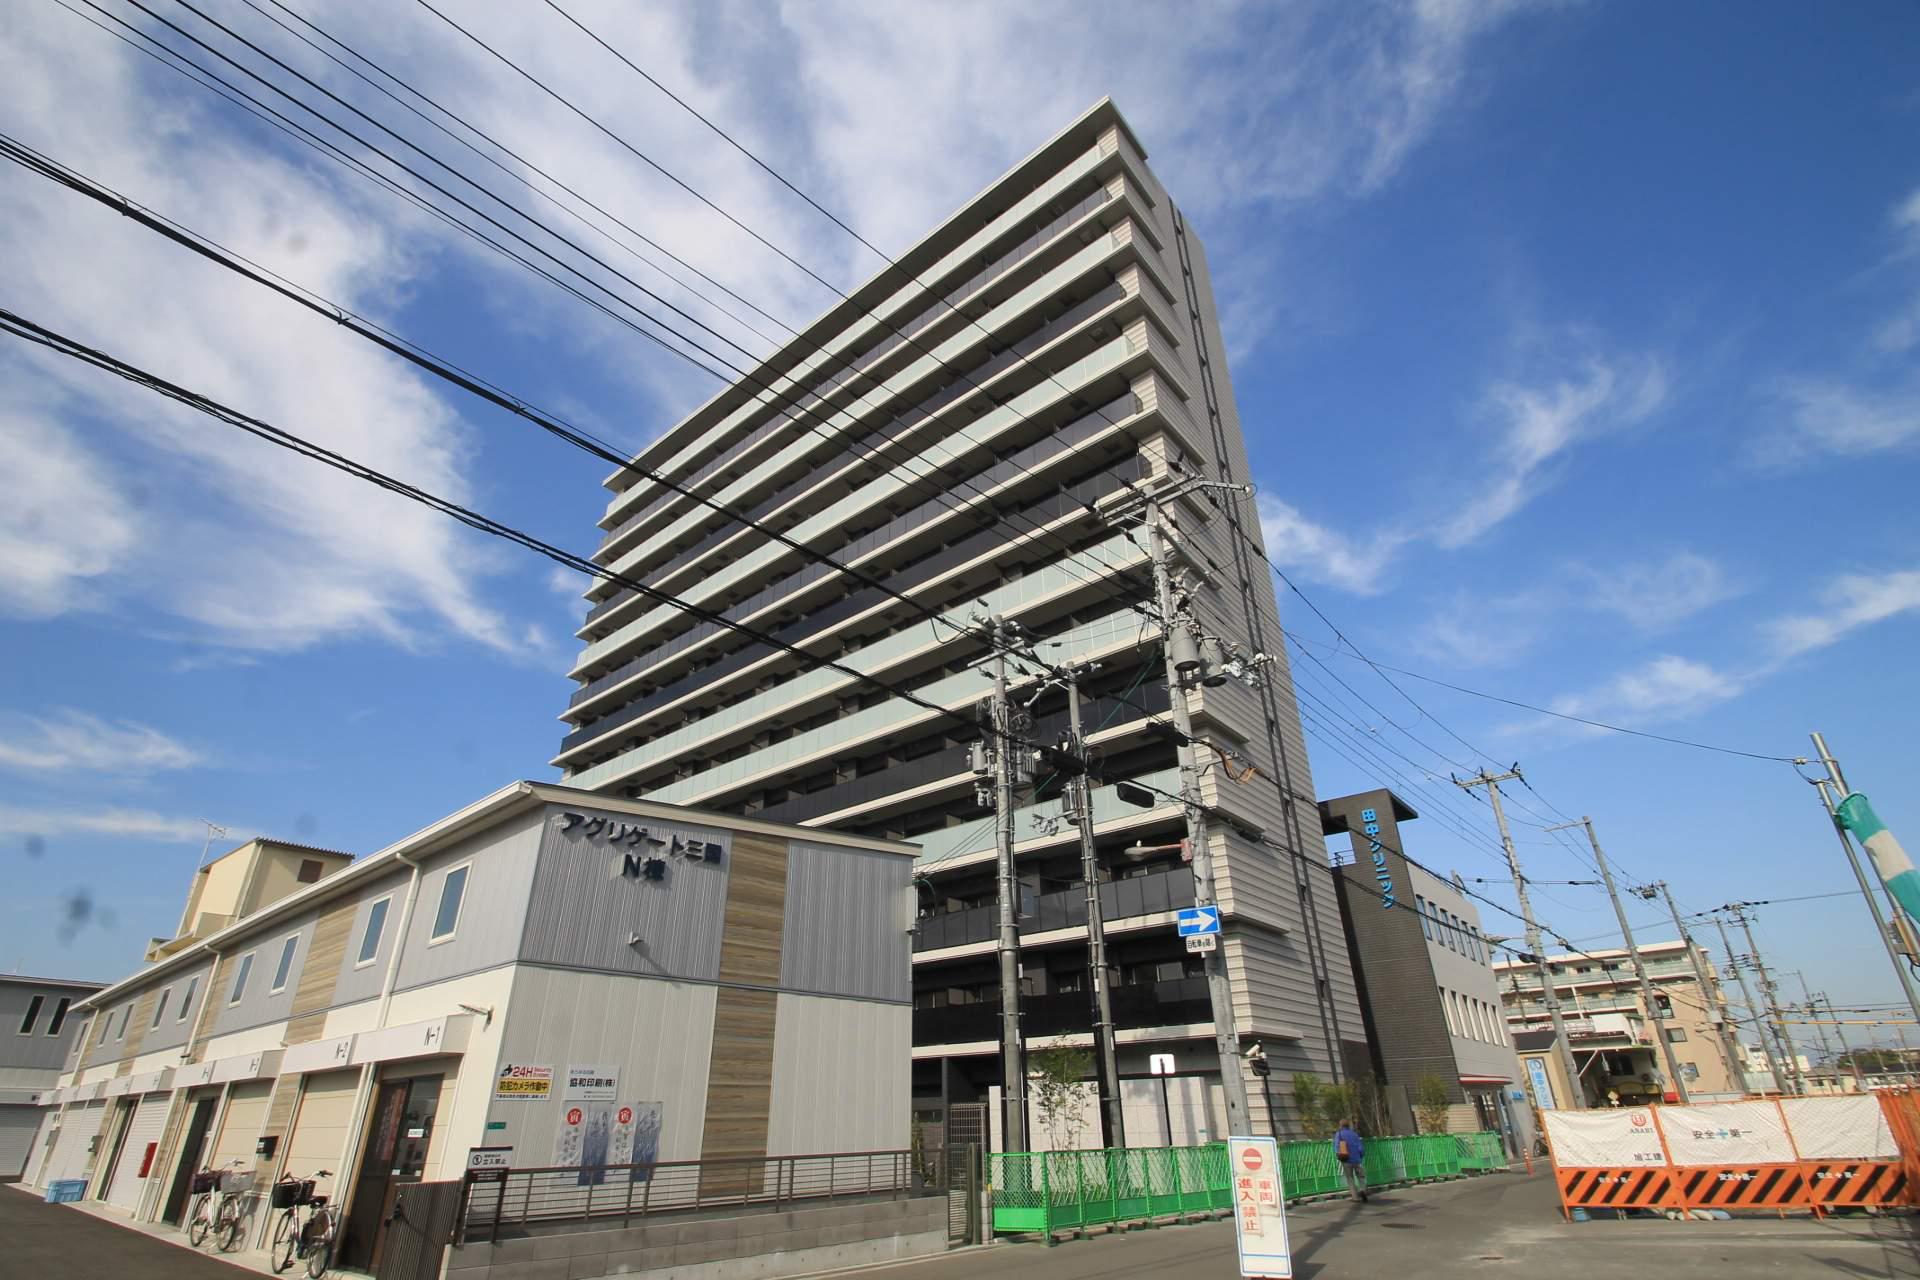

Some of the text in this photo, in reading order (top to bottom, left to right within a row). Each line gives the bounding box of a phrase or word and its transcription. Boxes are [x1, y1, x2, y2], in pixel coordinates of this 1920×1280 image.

[1361, 808, 1394, 909] 田中クリニック
[512, 1066, 533, 1078] 24H
[1237, 1178, 1260, 1232] 進入禁止
